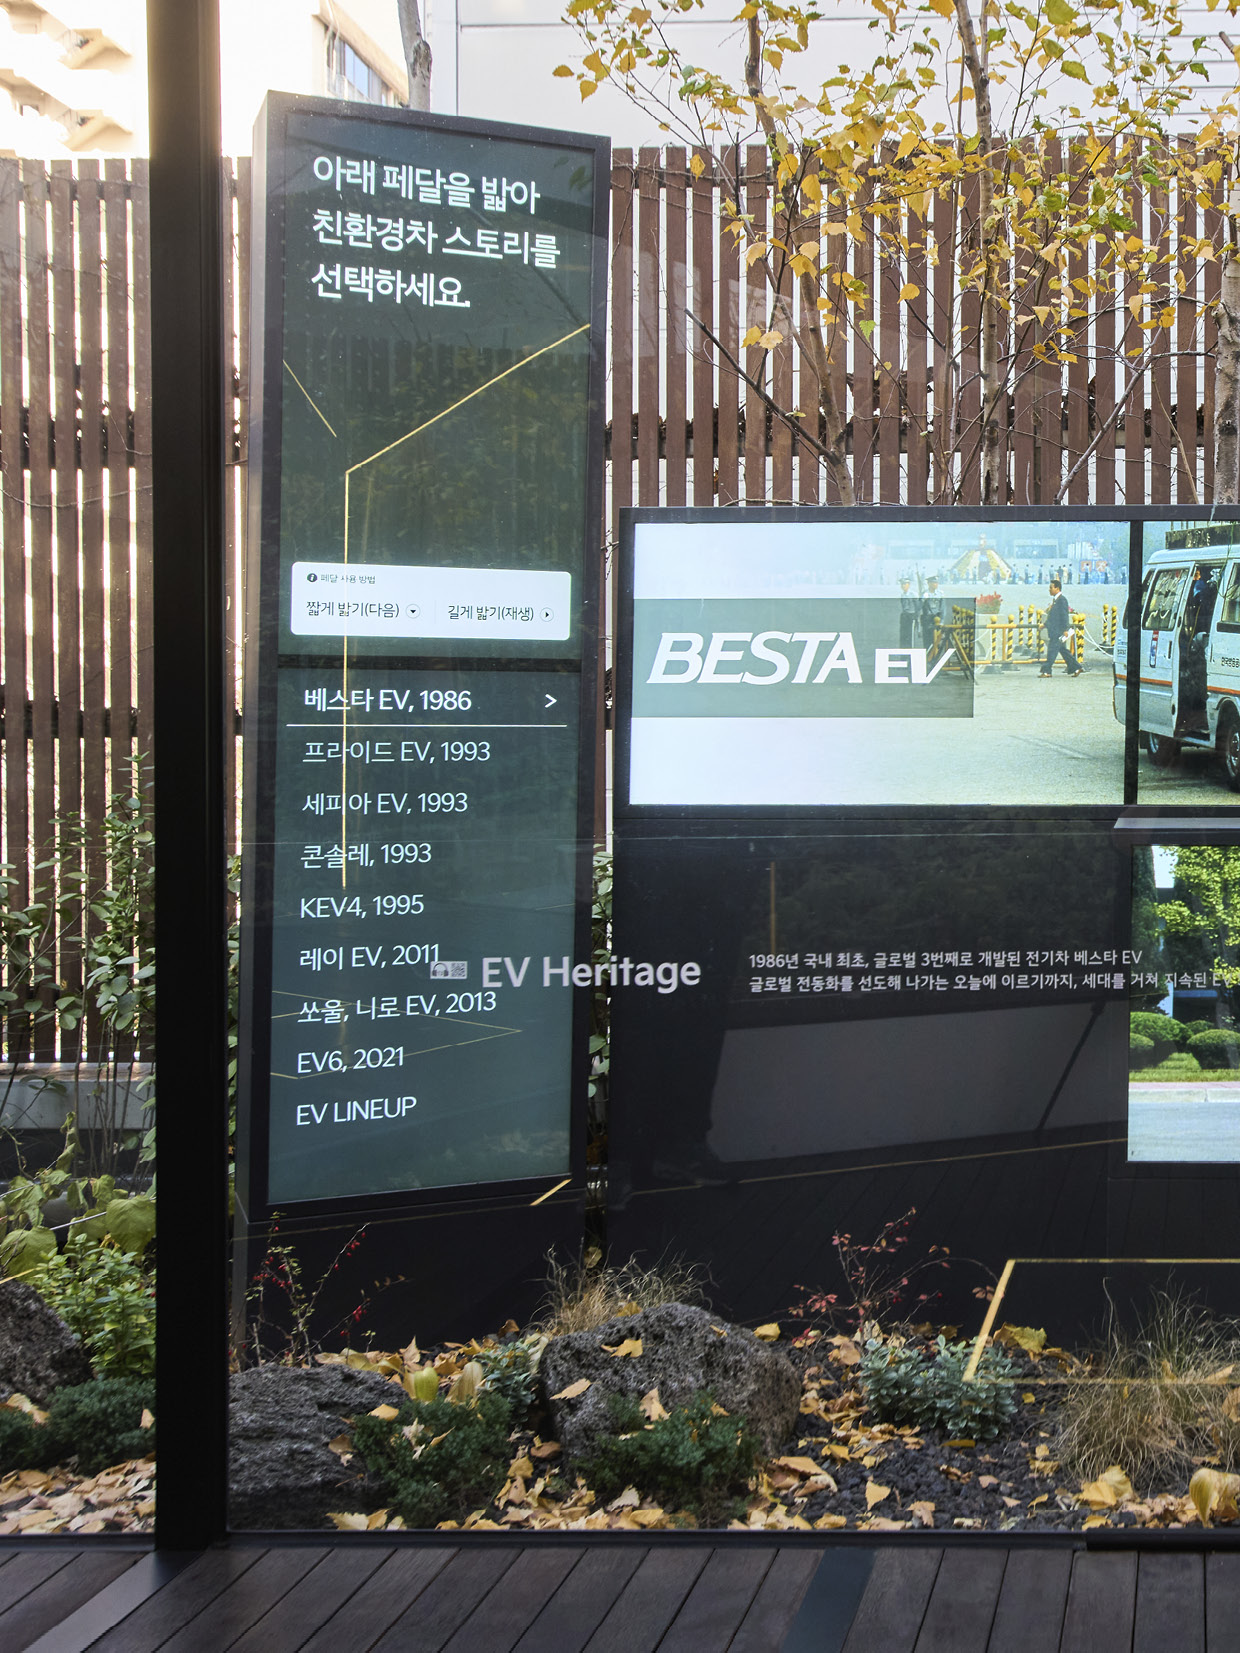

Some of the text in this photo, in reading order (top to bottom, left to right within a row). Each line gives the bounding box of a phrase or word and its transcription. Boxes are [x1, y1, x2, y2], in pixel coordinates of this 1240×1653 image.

[313, 155, 541, 214] 아래 페달을 밟아
[312, 208, 561, 269] 친환경차 스토리를
[320, 573, 376, 585] 페달 사용 방법
[306, 601, 400, 618] 짧게 밟기(다음)
[447, 605, 535, 622] 길게 밟기(재생)
[646, 630, 956, 686] BESTA EV
[304, 687, 473, 713] 베스타 EV, 1986
[302, 740, 491, 764] 프라이드 EV, 1993
[301, 792, 468, 816] 세피아 EV, 1993
[300, 843, 432, 869] 콘솔레, 1993
[299, 894, 424, 919] KEV4, 1995
[299, 943, 440, 972] 레이 EV, 2011
[749, 949, 1142, 969] 1986년 국내 최초, 글로벌 3번째로 개발된 전기차 베스타 EV
[481, 954, 702, 994] EV Heritage
[749, 975, 792, 992] 글로벌
[796, 975, 854, 992] 전동화를
[858, 974, 901, 991] 선도해
[906, 974, 949, 991] 나가는
[953, 974, 997, 990] 오늘에
[1001, 973, 1077, 990] 이르기까지,
[1082, 973, 1126, 989] 세대를
[1130, 972, 1158, 988] 거쳐
[1165, 972, 1207, 988] 지속된
[1212, 972, 1232, 986] EV
[297, 991, 497, 1024] 쏘울, 니로 EV, 2013
[297, 1046, 404, 1074] EV6, 2021
[295, 1096, 417, 1126] EV LINEUP
